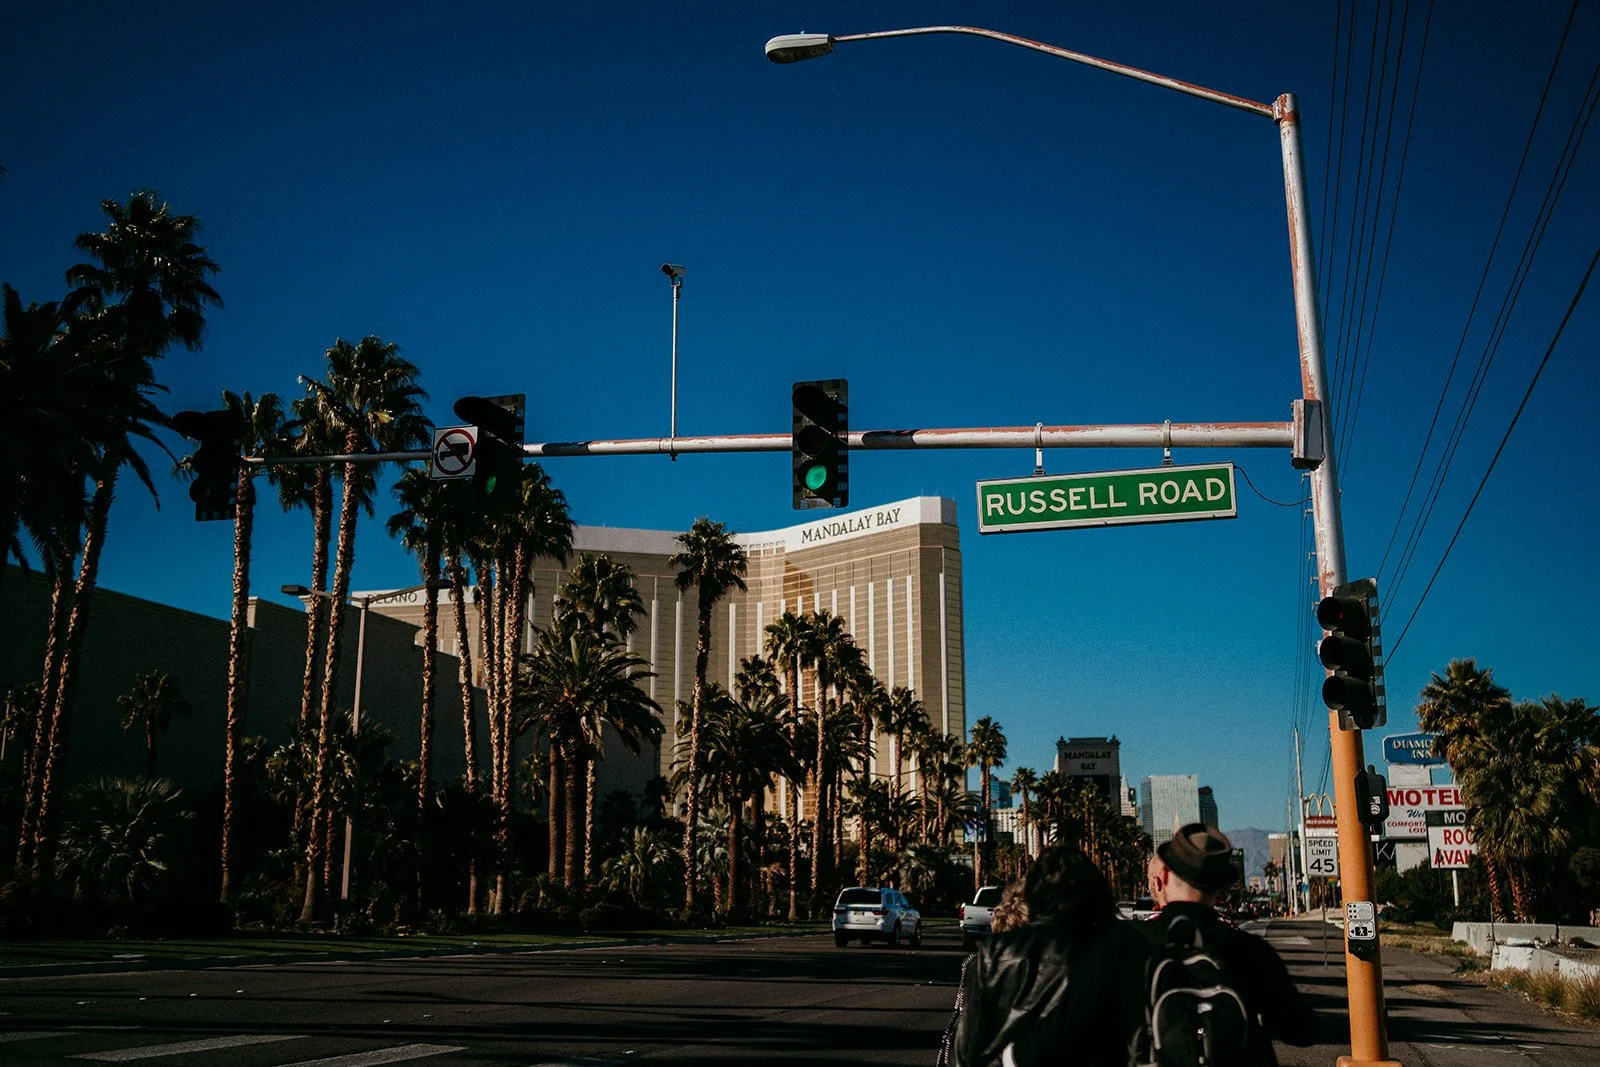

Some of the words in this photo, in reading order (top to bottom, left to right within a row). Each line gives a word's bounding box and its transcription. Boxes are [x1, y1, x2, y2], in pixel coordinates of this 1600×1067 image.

[986, 485, 1127, 517] RUSSELL
[1138, 478, 1226, 506] ROAD
[801, 514, 873, 544] MANDALAY
[876, 508, 901, 527] BAY
[1064, 751, 1111, 759] MANDALAY
[1081, 762, 1096, 770] BAY
[1387, 788, 1465, 806] MOTEL
[1311, 848, 1331, 856] LIMIT
[1309, 858, 1335, 873] 45
